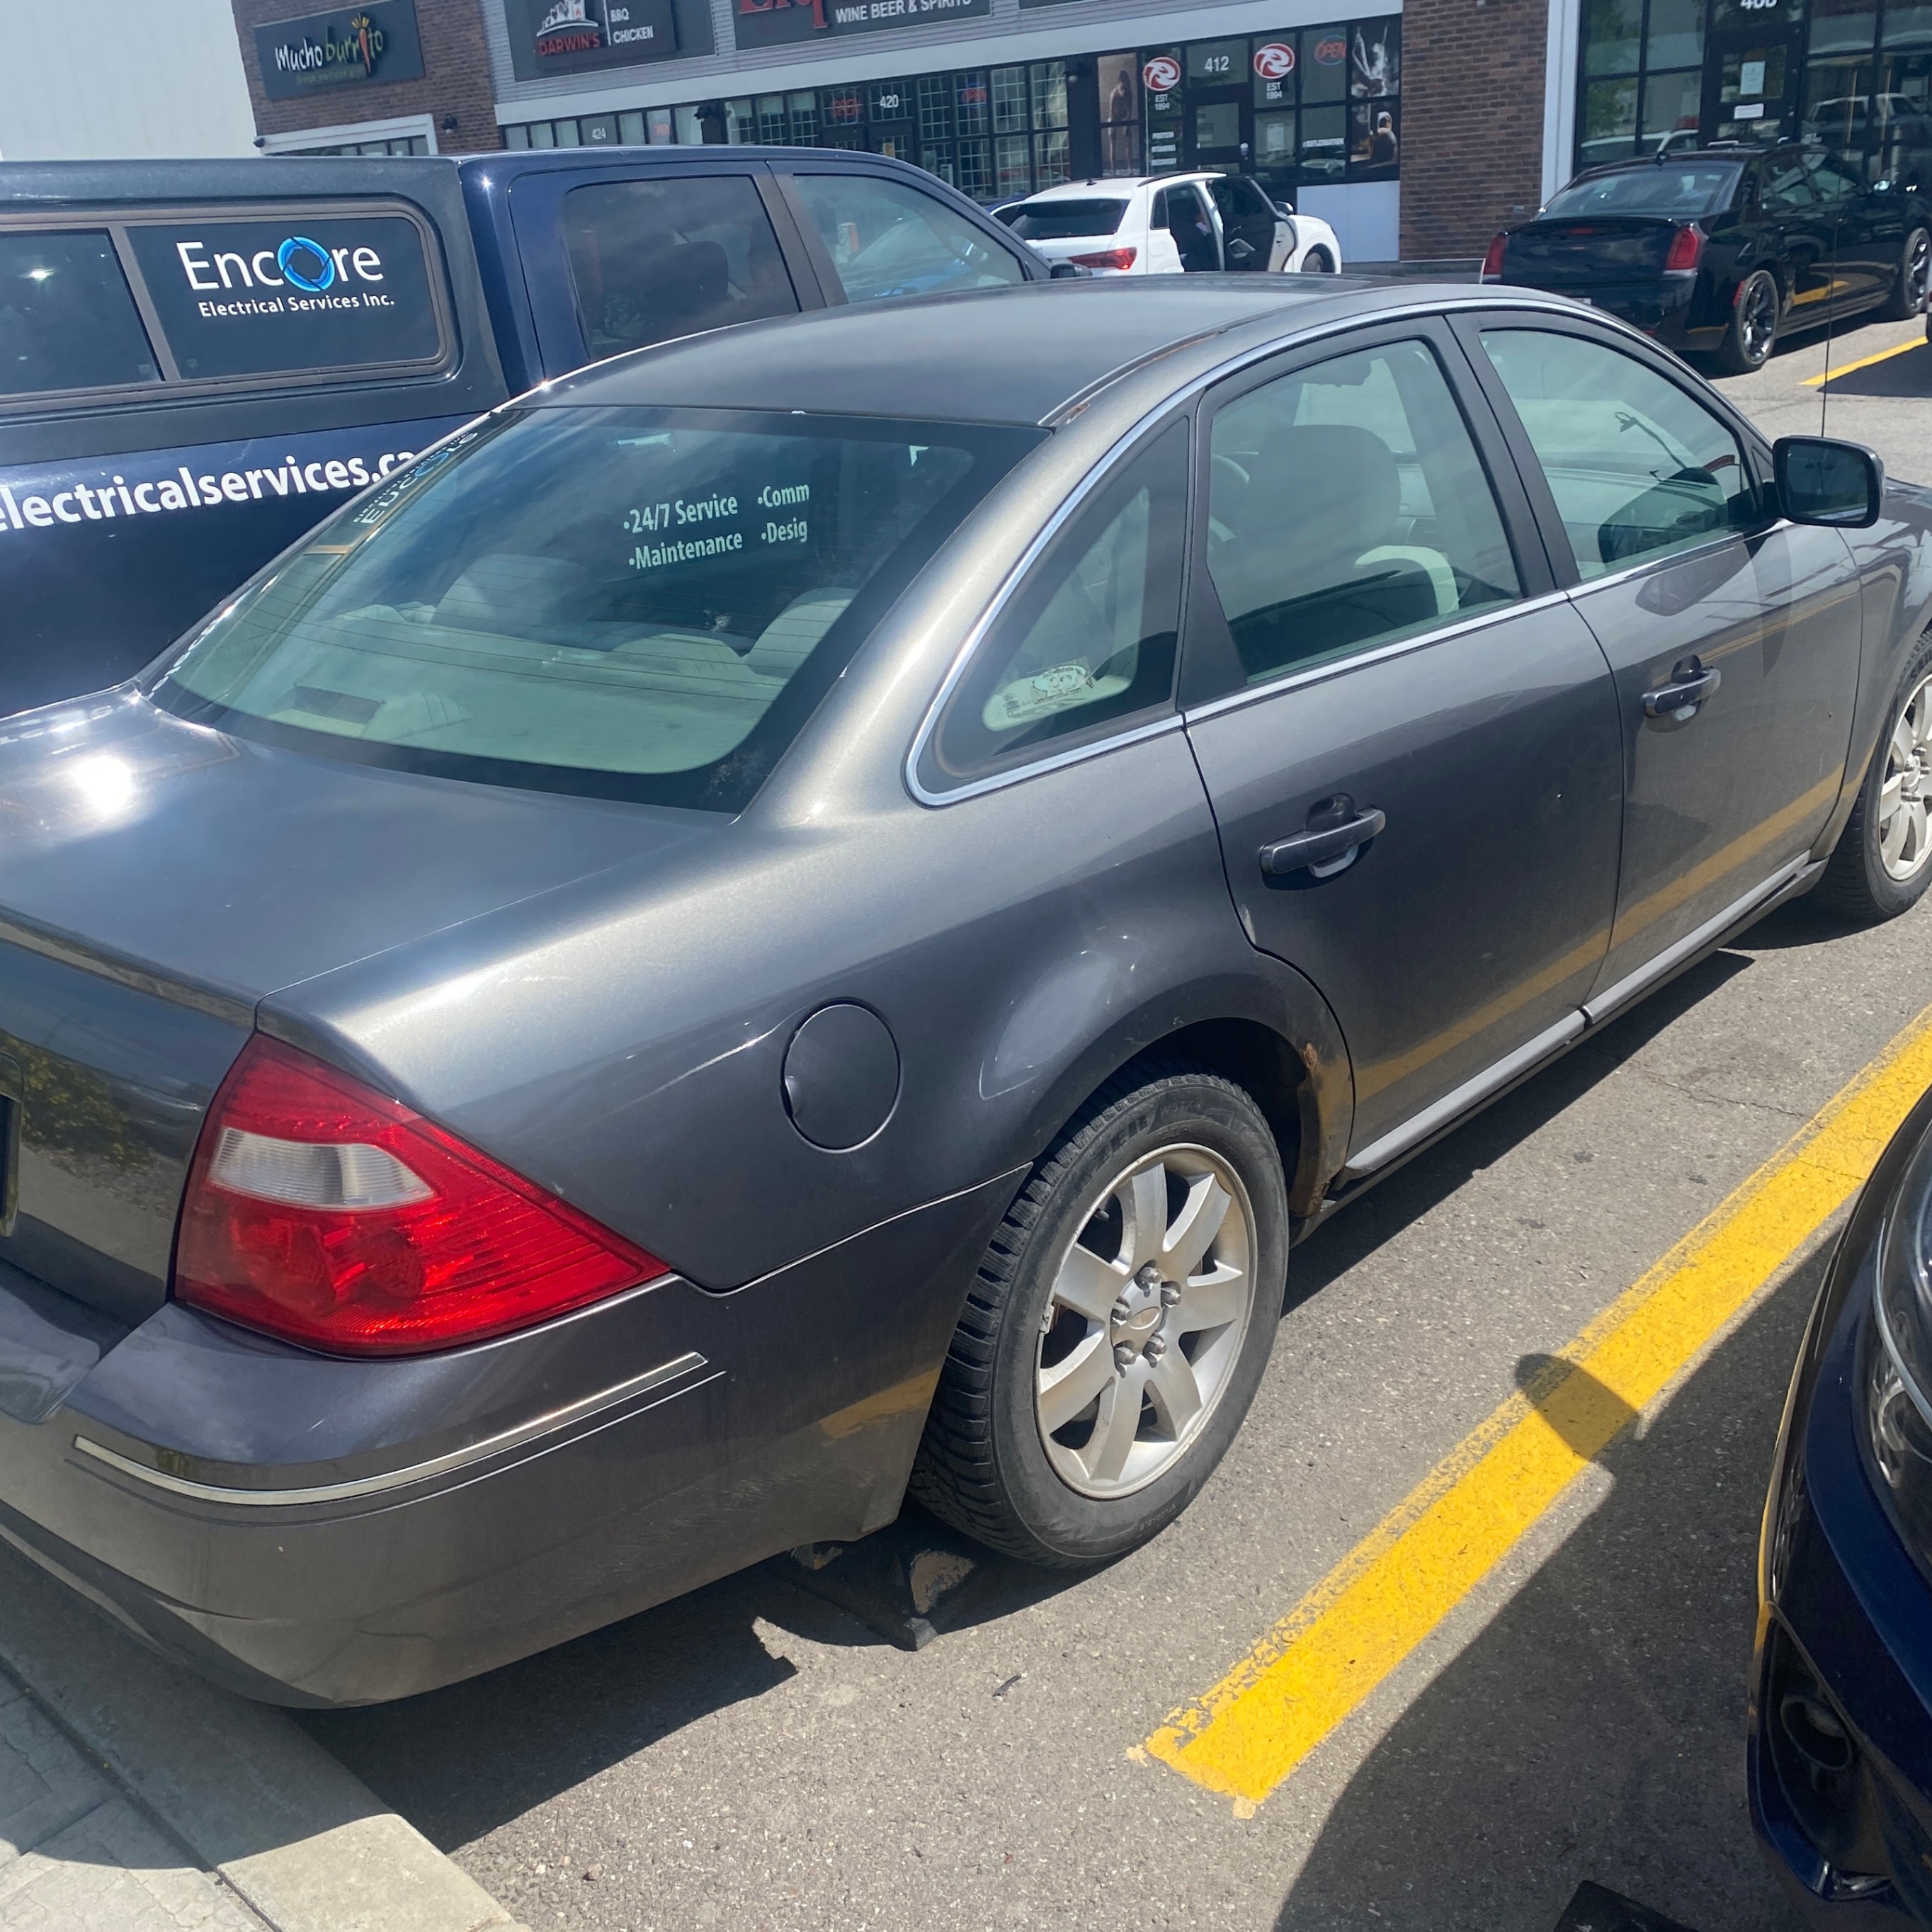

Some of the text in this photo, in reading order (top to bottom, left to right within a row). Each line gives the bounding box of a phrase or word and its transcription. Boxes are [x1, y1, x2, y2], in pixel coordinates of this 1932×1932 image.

[610, 8, 630, 23] BBQ
[835, 5, 868, 23] WINE
[870, 1, 906, 18] BEER
[908, 0, 918, 13] &
[538, 33, 600, 56] DARWIN'S
[613, 25, 654, 44] CHICKEN
[275, 21, 383, 74] Mucho burrito
[1205, 56, 1229, 72] 412
[1267, 81, 1281, 91] EST
[880, 94, 899, 108] 420
[1155, 93, 1168, 103] EST
[591, 128, 606, 140] 424
[176, 236, 384, 292] Encore
[198, 292, 394, 317] Electrical Services Inc.
[630, 484, 809, 533] 24/7 Service Comm
[635, 517, 807, 569] Maintenance Desig
